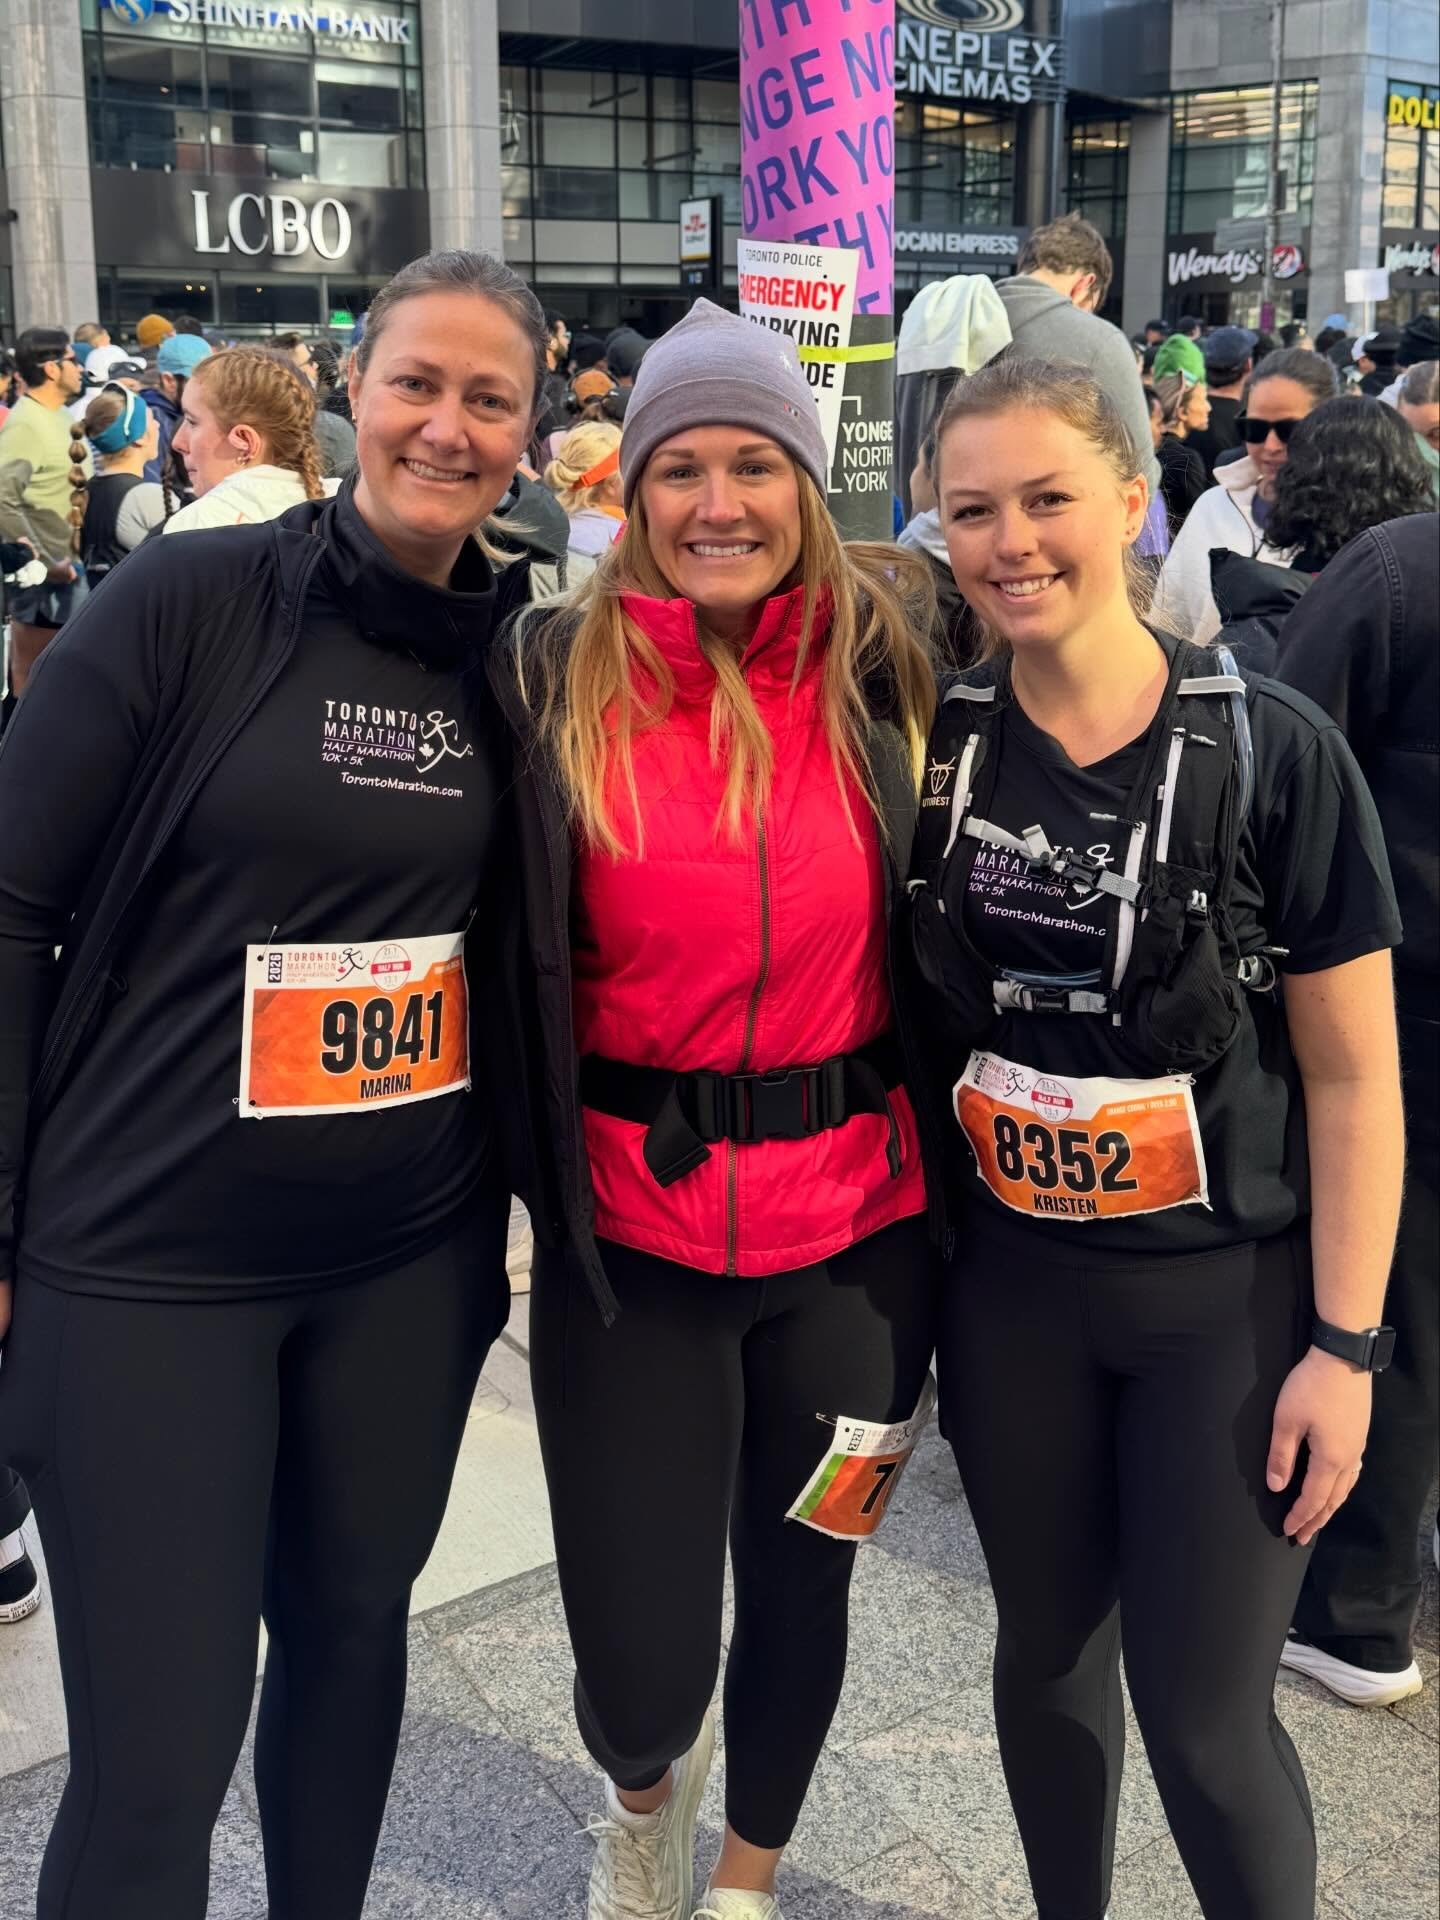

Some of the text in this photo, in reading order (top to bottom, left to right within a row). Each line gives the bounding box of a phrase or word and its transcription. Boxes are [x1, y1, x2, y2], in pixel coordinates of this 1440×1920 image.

[168, 0, 411, 45] SHINHAN BANK
[898, 23, 1056, 77] NEPLEX
[895, 61, 1032, 104] CINEMAS
[1388, 94, 1440, 129] DOL
[191, 189, 352, 260] LCBO
[945, 233, 1019, 255] EMPRESS
[783, 252, 823, 267] POLICE
[1168, 247, 1259, 286] Wendy's
[842, 420, 893, 443] YONGE
[842, 446, 893, 468] NORTH
[843, 471, 888, 493] YORK
[325, 700, 418, 732] TORONTO
[324, 721, 416, 750] MARATHON
[321, 752, 365, 767] 10K 5K
[322, 740, 416, 763] HALF MARATHON
[341, 771, 463, 798] TorontoMarathon.com
[968, 882, 1007, 897] 10K 5K
[970, 870, 1067, 898] HALF MARATHON
[269, 953, 282, 982] 2026
[287, 952, 337, 961] TORONTO
[321, 990, 444, 1076] 9841
[360, 1072, 412, 1099] MARINA
[993, 1113, 1139, 1194] 8352
[1033, 1193, 1098, 1215] KRISTEN
[860, 1460, 899, 1514] 7
